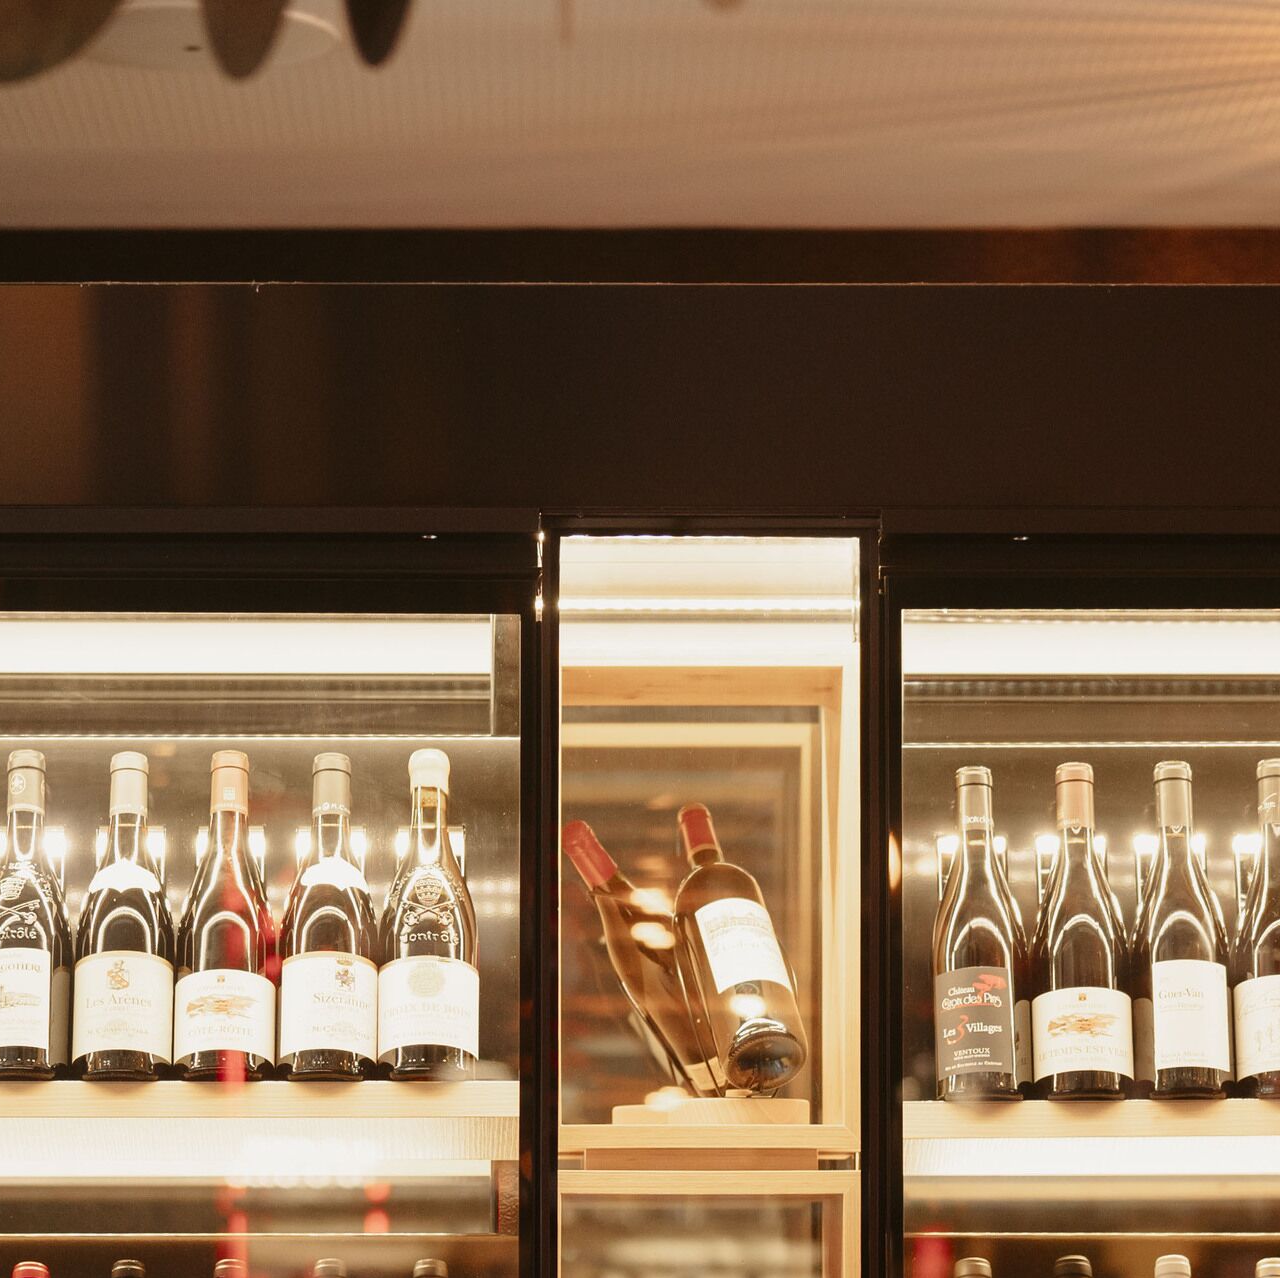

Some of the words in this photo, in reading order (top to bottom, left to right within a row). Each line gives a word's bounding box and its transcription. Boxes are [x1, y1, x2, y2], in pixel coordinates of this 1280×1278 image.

[948, 985, 975, 997] Château
[962, 993, 982, 1004] des
[943, 1028, 956, 1039] Les
[966, 1021, 1003, 1034] Villages
[954, 1047, 991, 1058] VENTOUX
